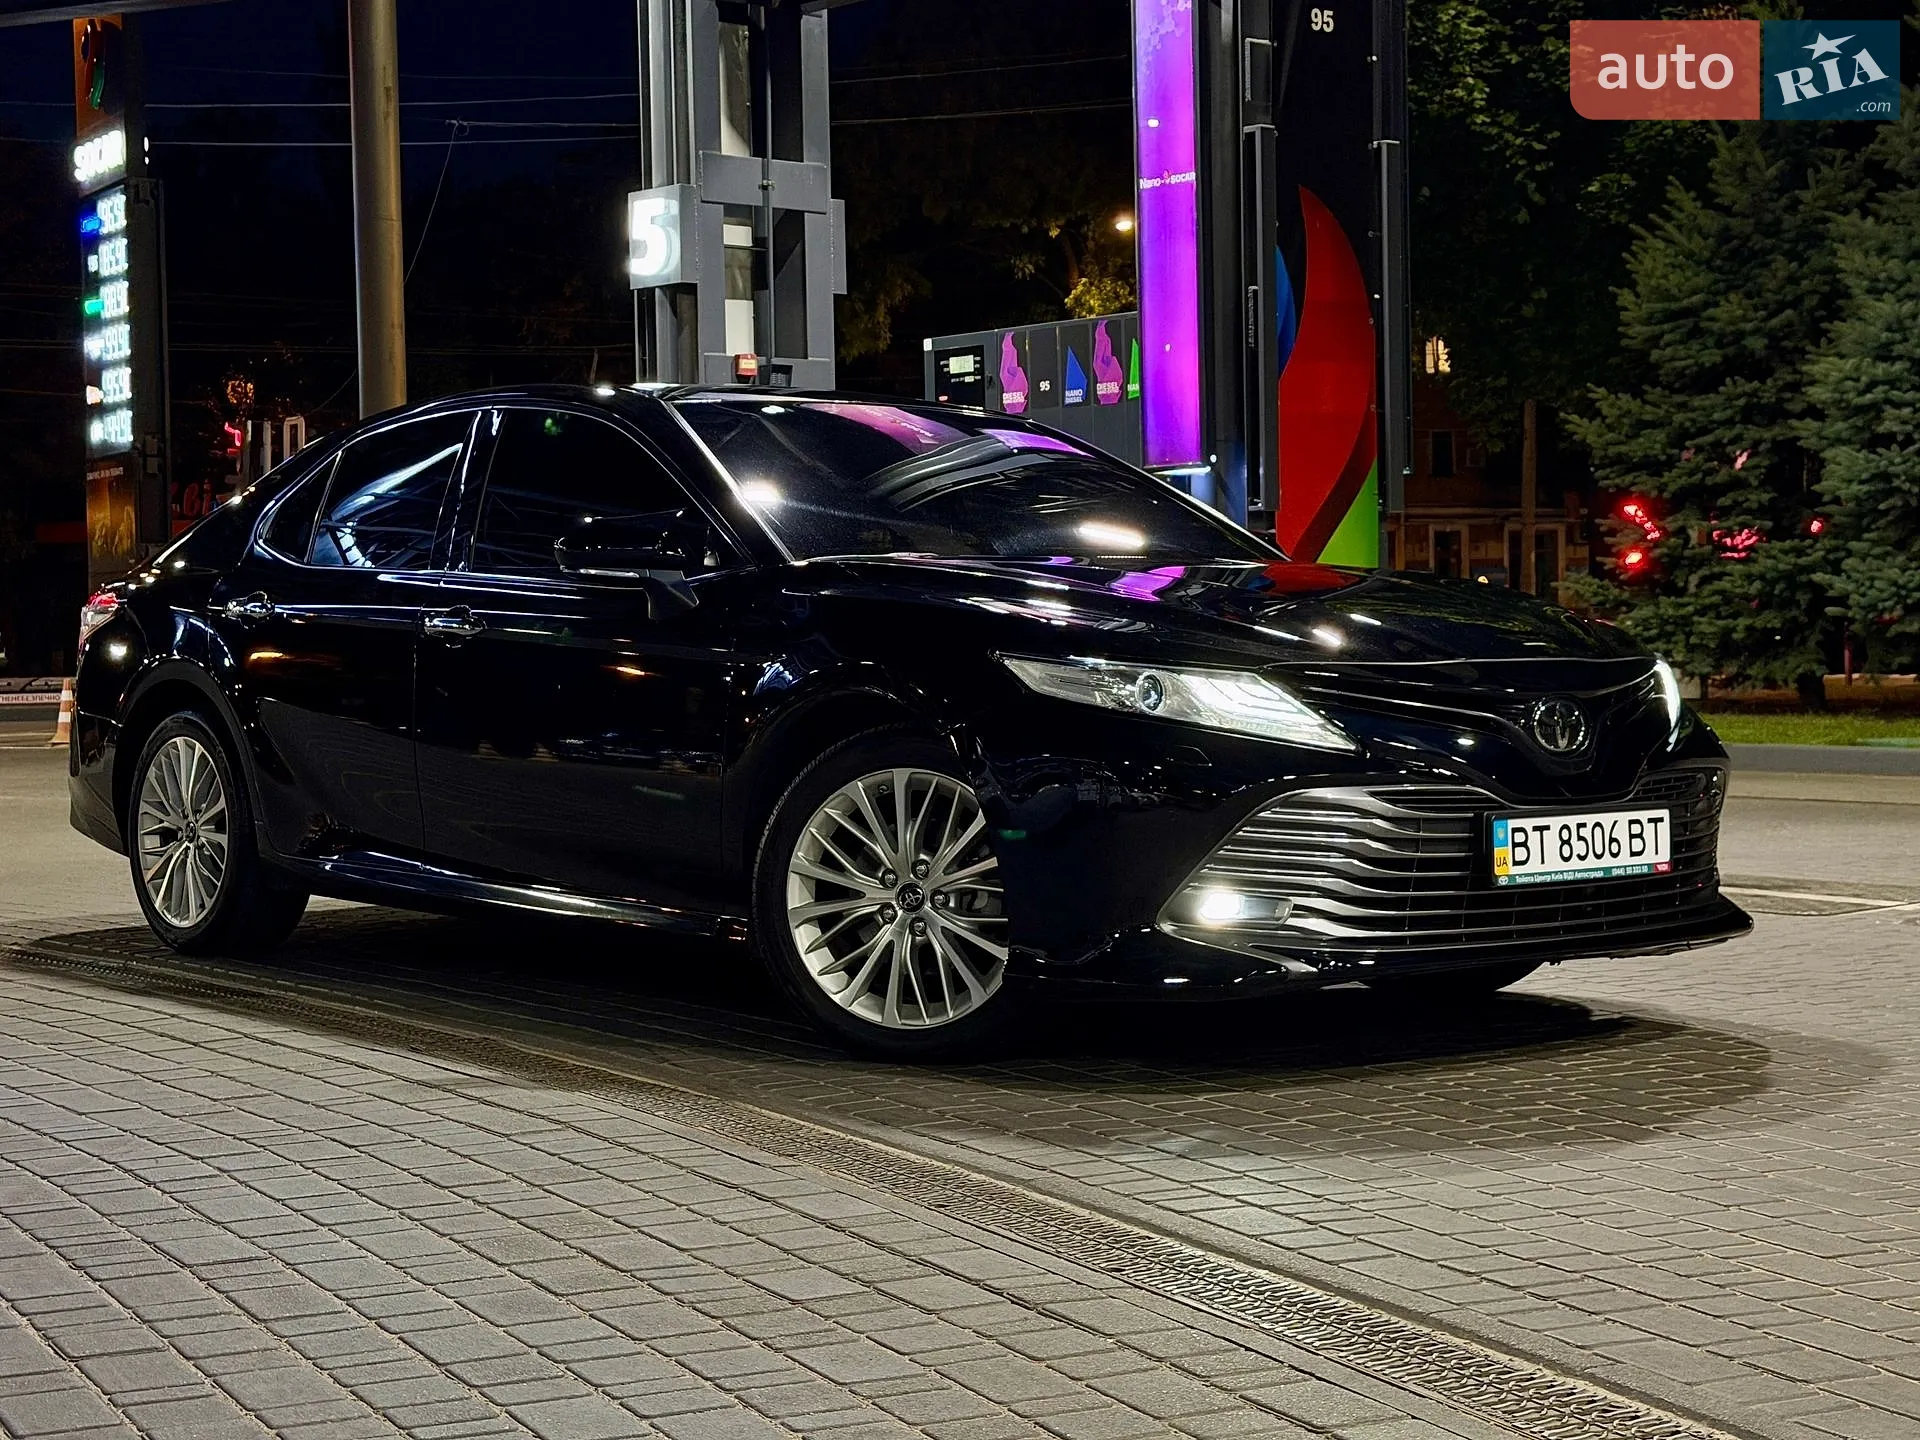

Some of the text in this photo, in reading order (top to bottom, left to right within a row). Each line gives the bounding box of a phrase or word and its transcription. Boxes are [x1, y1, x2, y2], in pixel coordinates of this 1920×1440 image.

[1311, 8, 1334, 32] 95
[631, 197, 677, 276] 5
[1040, 380, 1050, 391] 95
[1065, 389, 1083, 398] NANO
[1511, 817, 1664, 867] BT 8506 BT
[1495, 856, 1508, 867] UA
